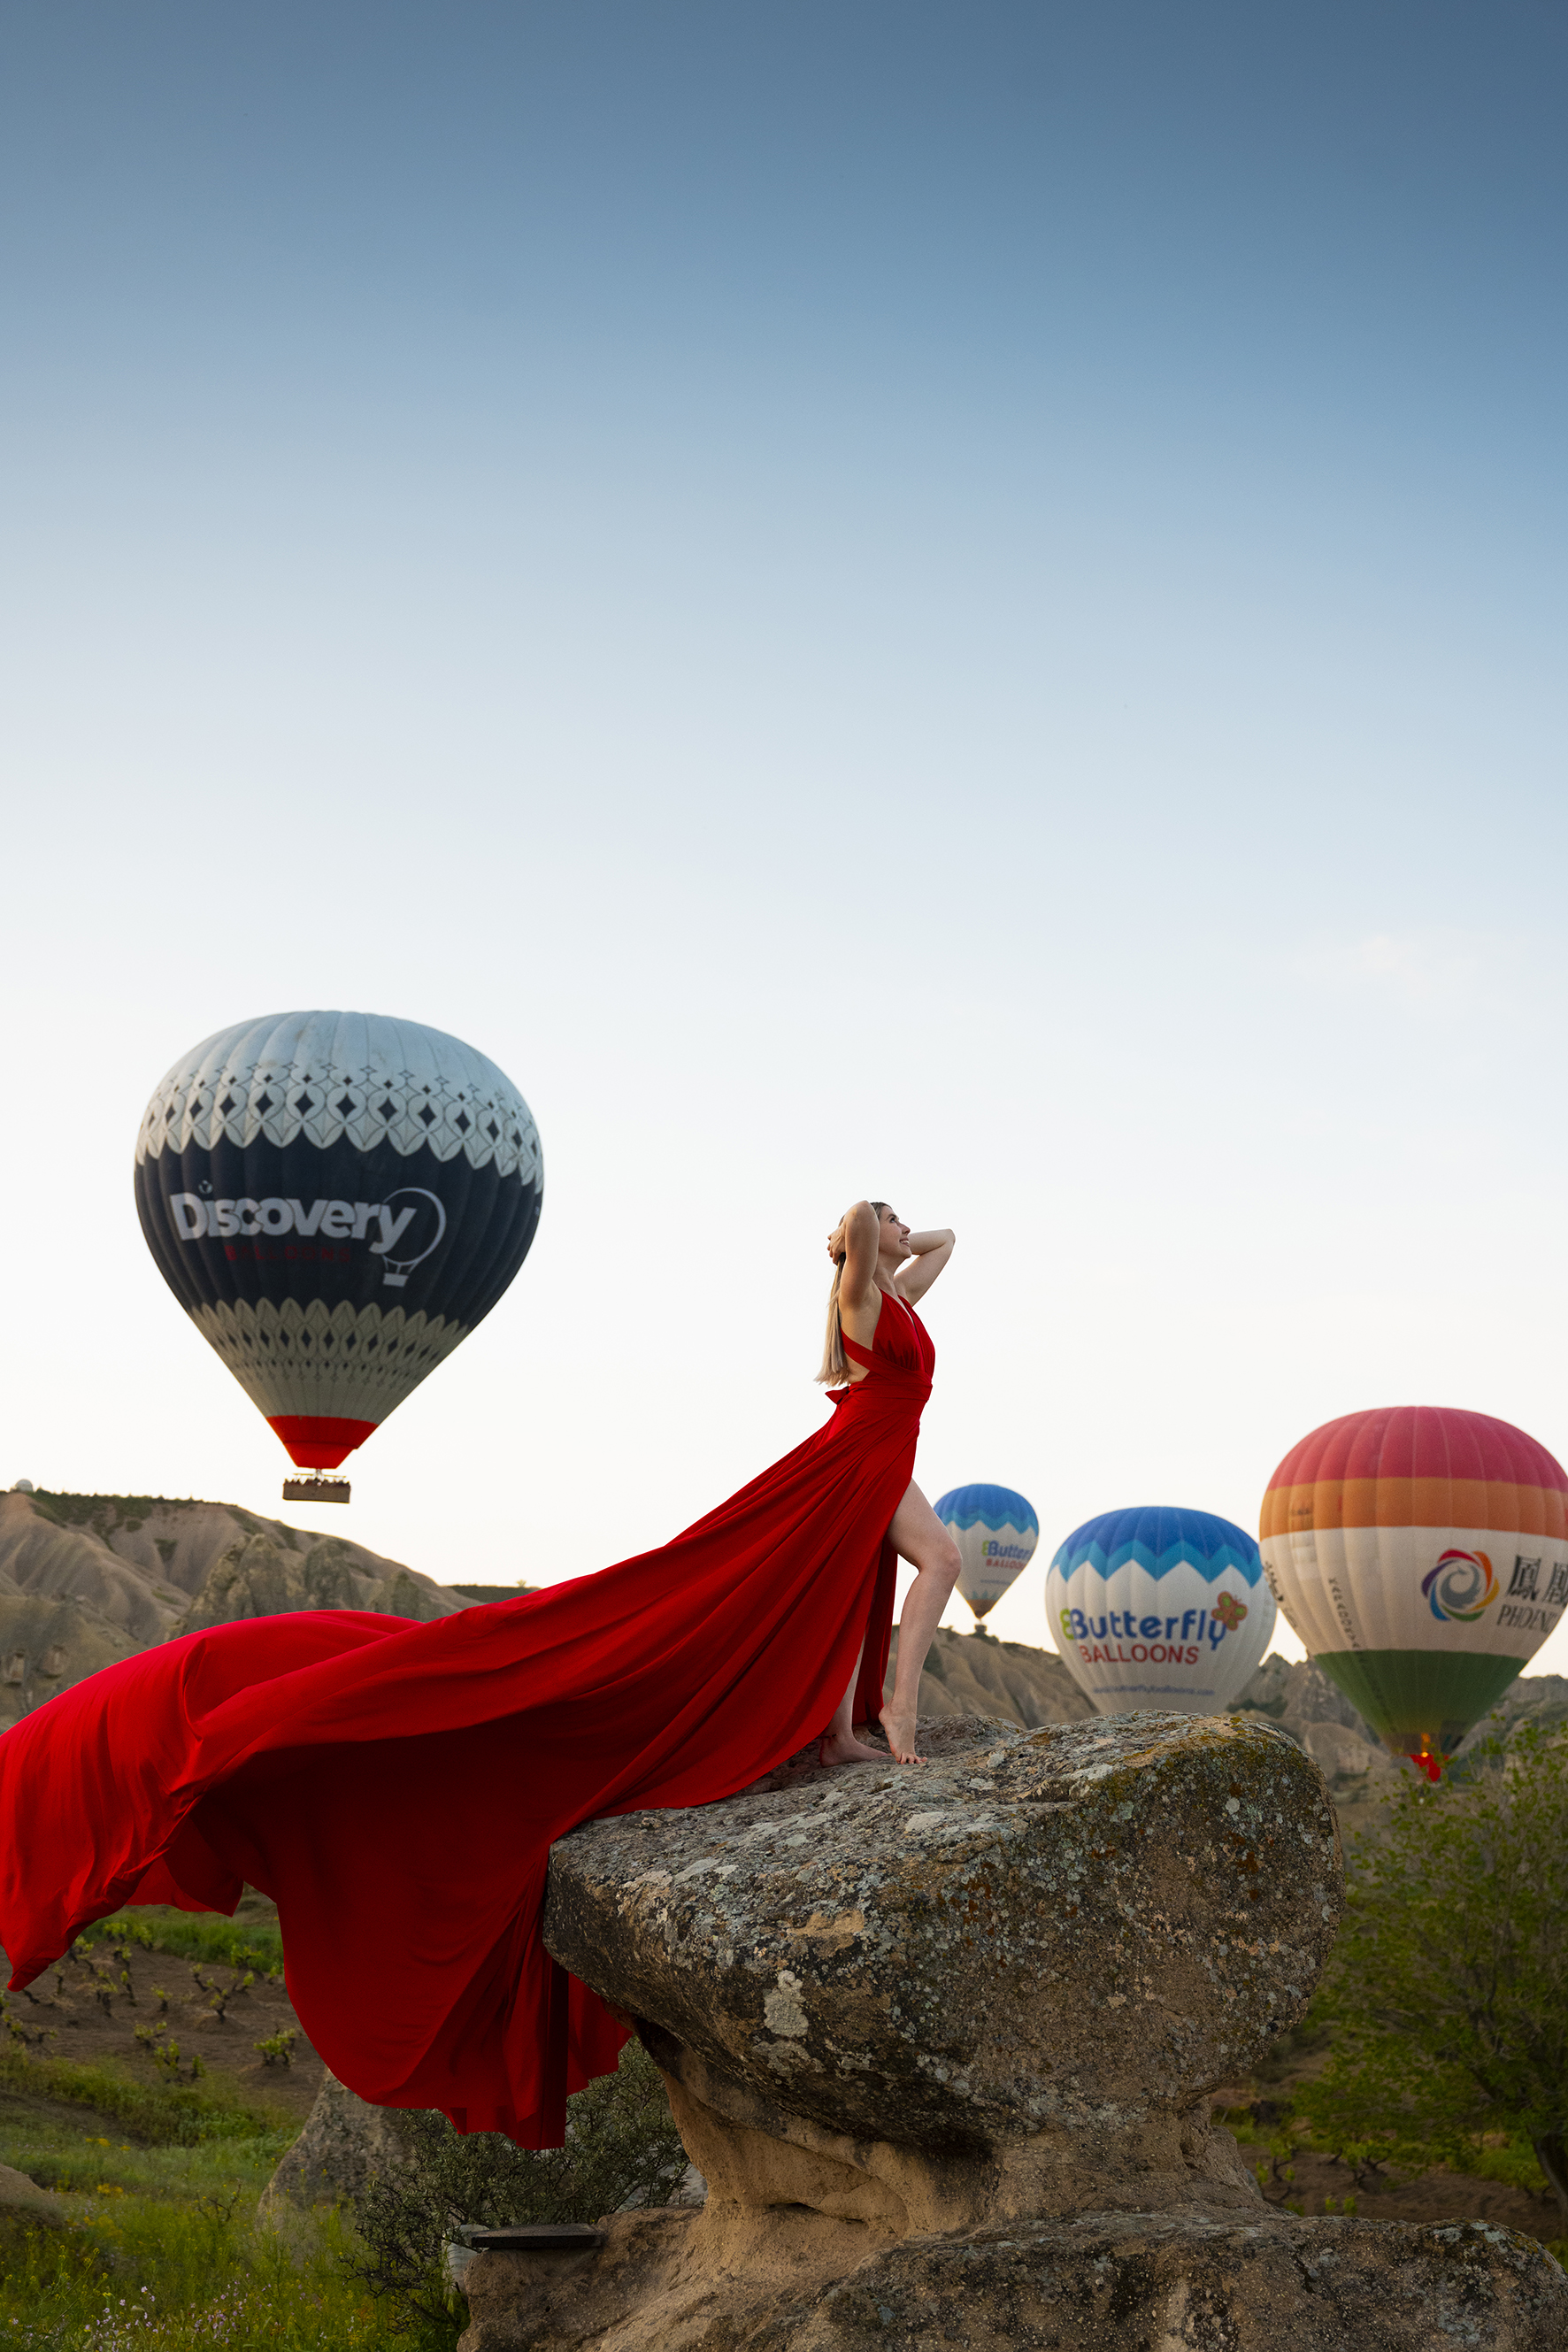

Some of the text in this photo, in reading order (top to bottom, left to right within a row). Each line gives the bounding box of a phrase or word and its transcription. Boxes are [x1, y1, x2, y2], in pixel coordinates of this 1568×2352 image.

[170, 1180, 417, 1254] Discovery
[224, 1245, 351, 1263] BALLOONS
[1059, 1607, 1227, 1651] Butterfly
[1079, 1644, 1200, 1664] BALLOONS
